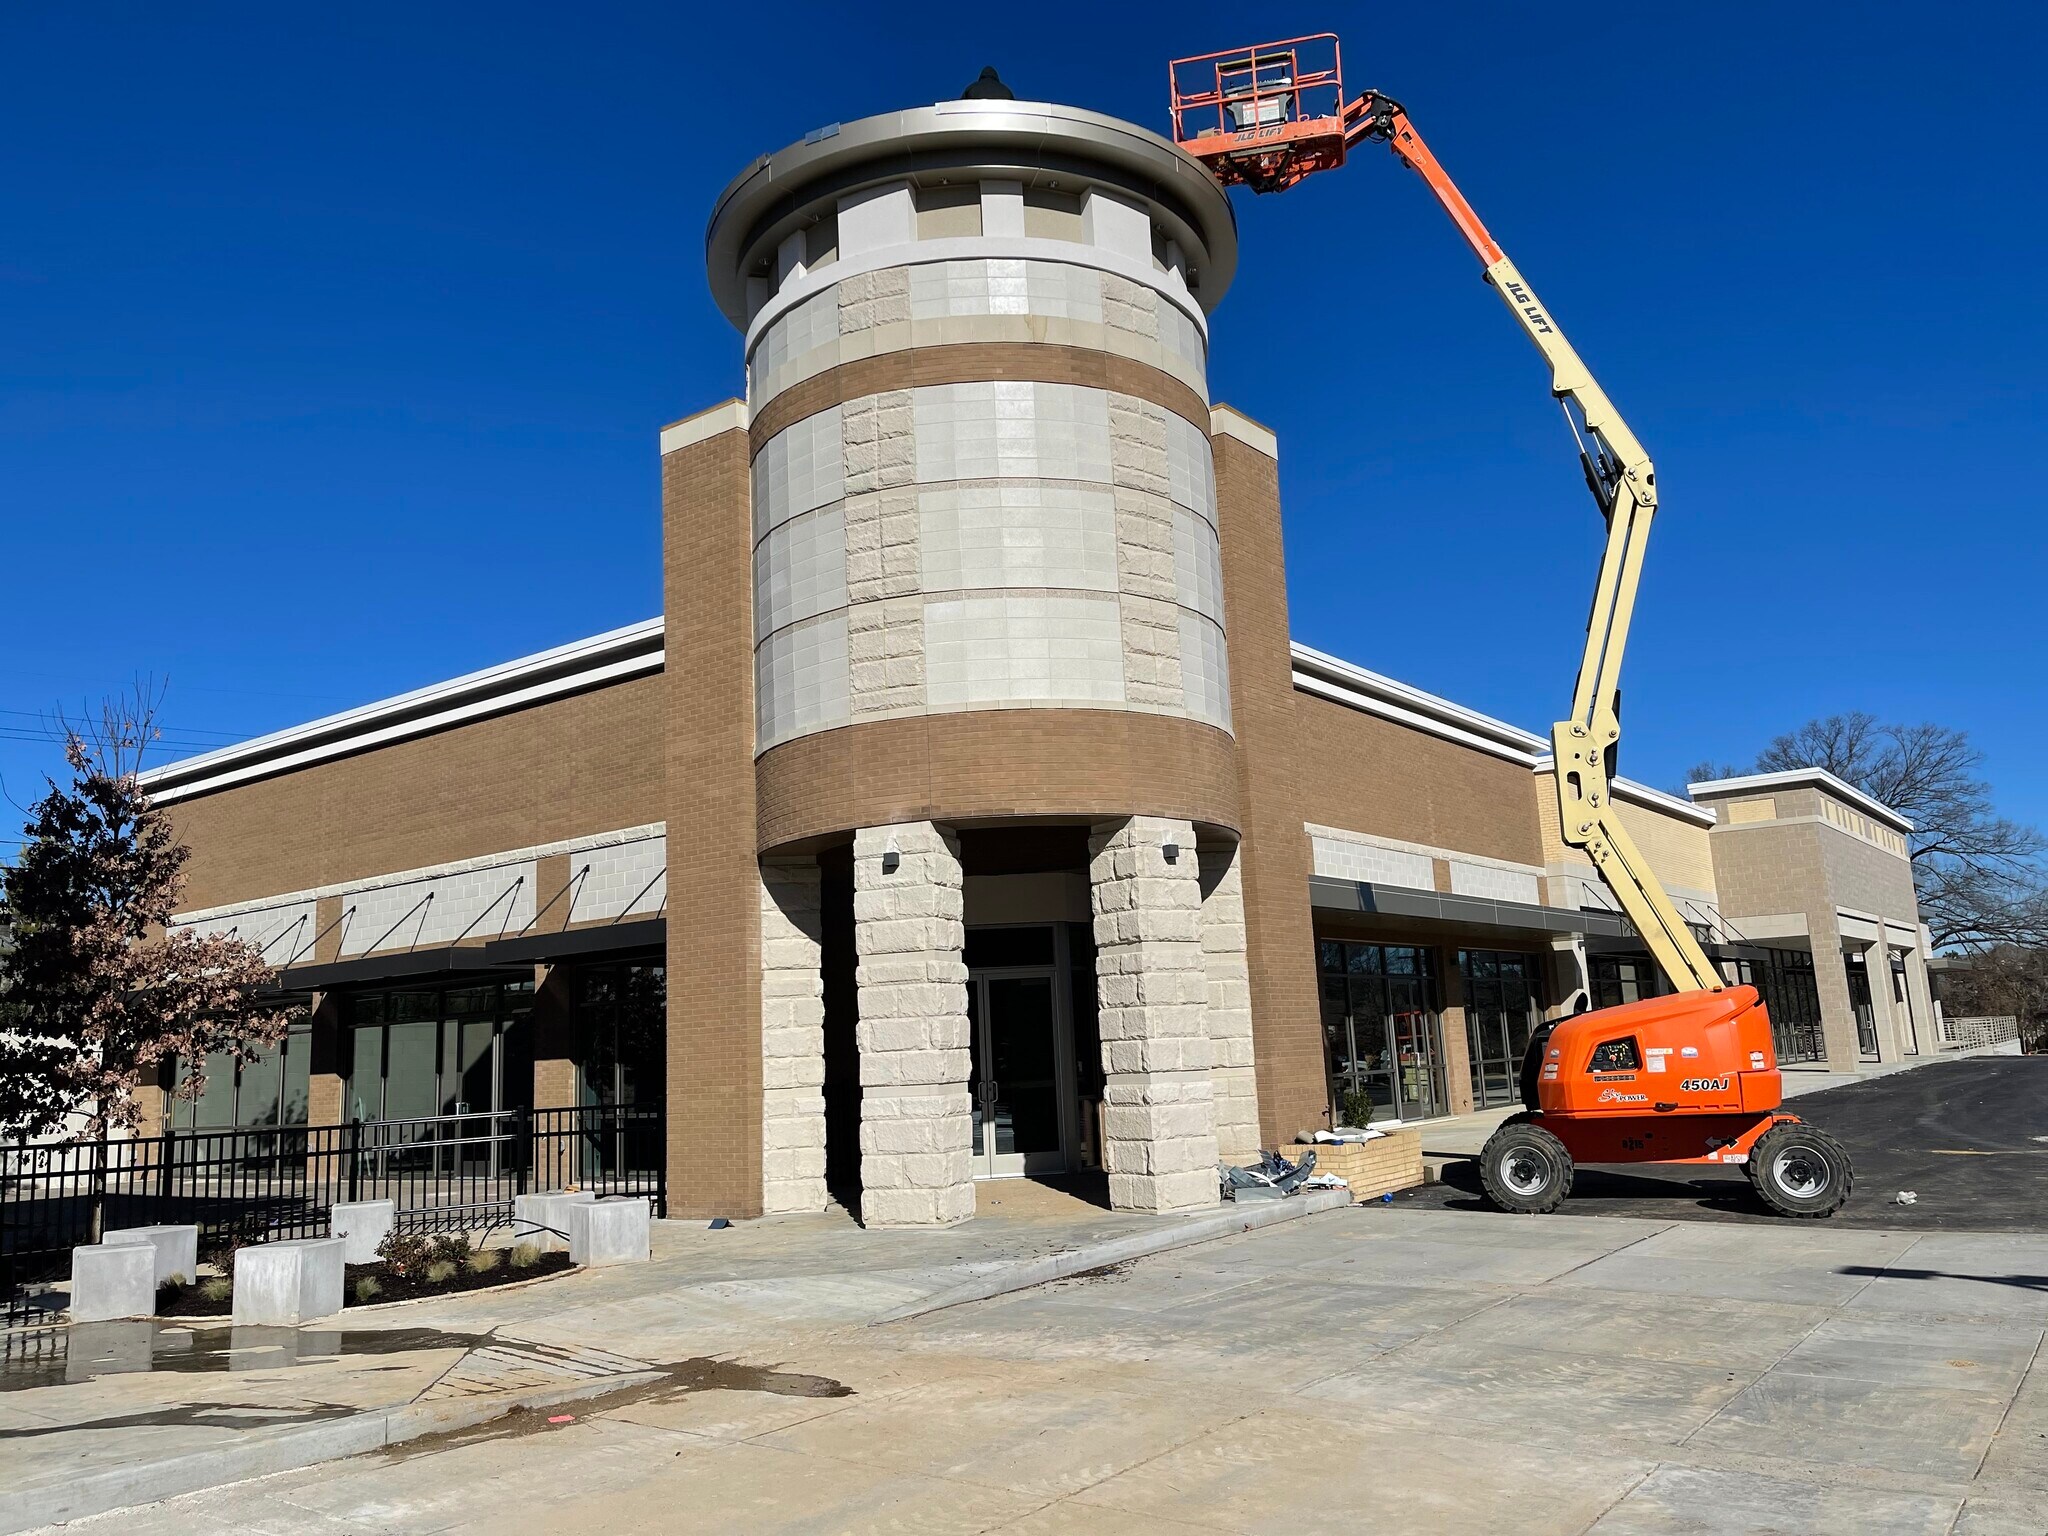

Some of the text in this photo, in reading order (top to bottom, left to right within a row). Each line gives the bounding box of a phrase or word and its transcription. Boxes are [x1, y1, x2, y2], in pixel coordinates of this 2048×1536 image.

[1234, 127, 1285, 142] JLG LIFT
[1505, 281, 1553, 334] JLG LIFT
[1681, 1079, 1729, 1091] 450AJ
